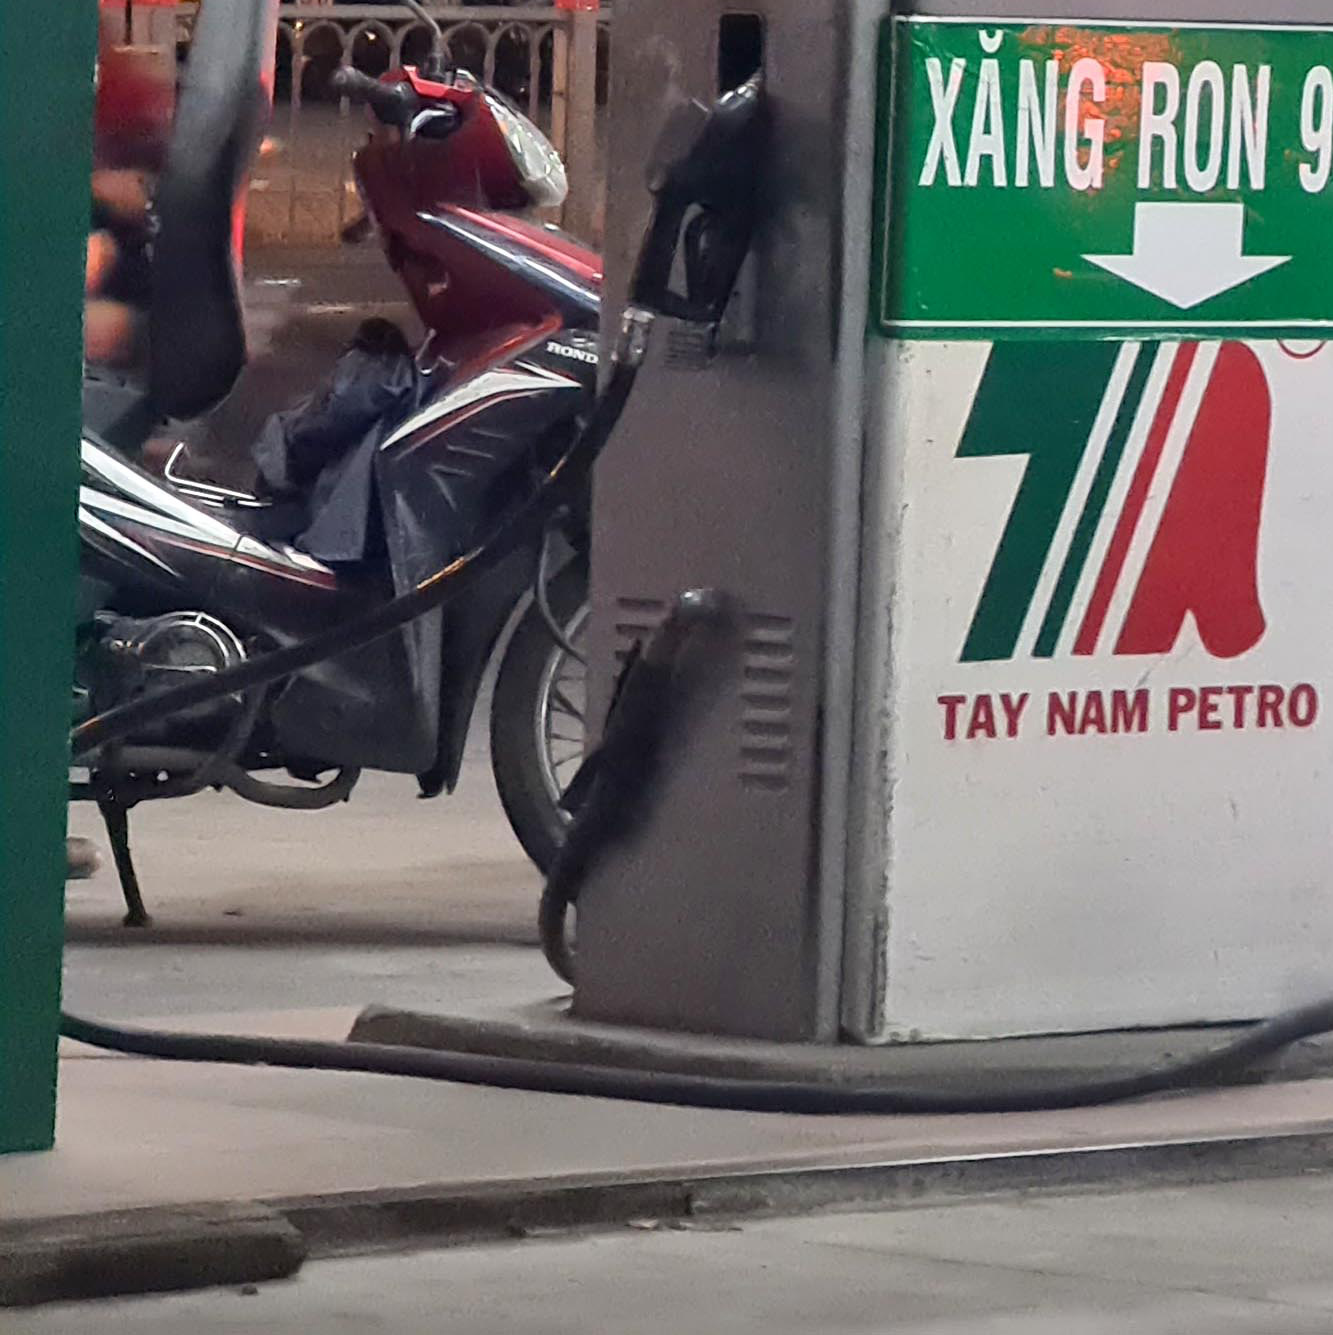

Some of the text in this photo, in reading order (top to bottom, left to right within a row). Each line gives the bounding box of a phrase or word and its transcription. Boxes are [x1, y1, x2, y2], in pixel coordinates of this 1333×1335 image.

[918, 30, 1105, 192] XĂNG
[1137, 60, 1271, 193] RON
[937, 682, 1319, 740] TAY NAM PETRO
